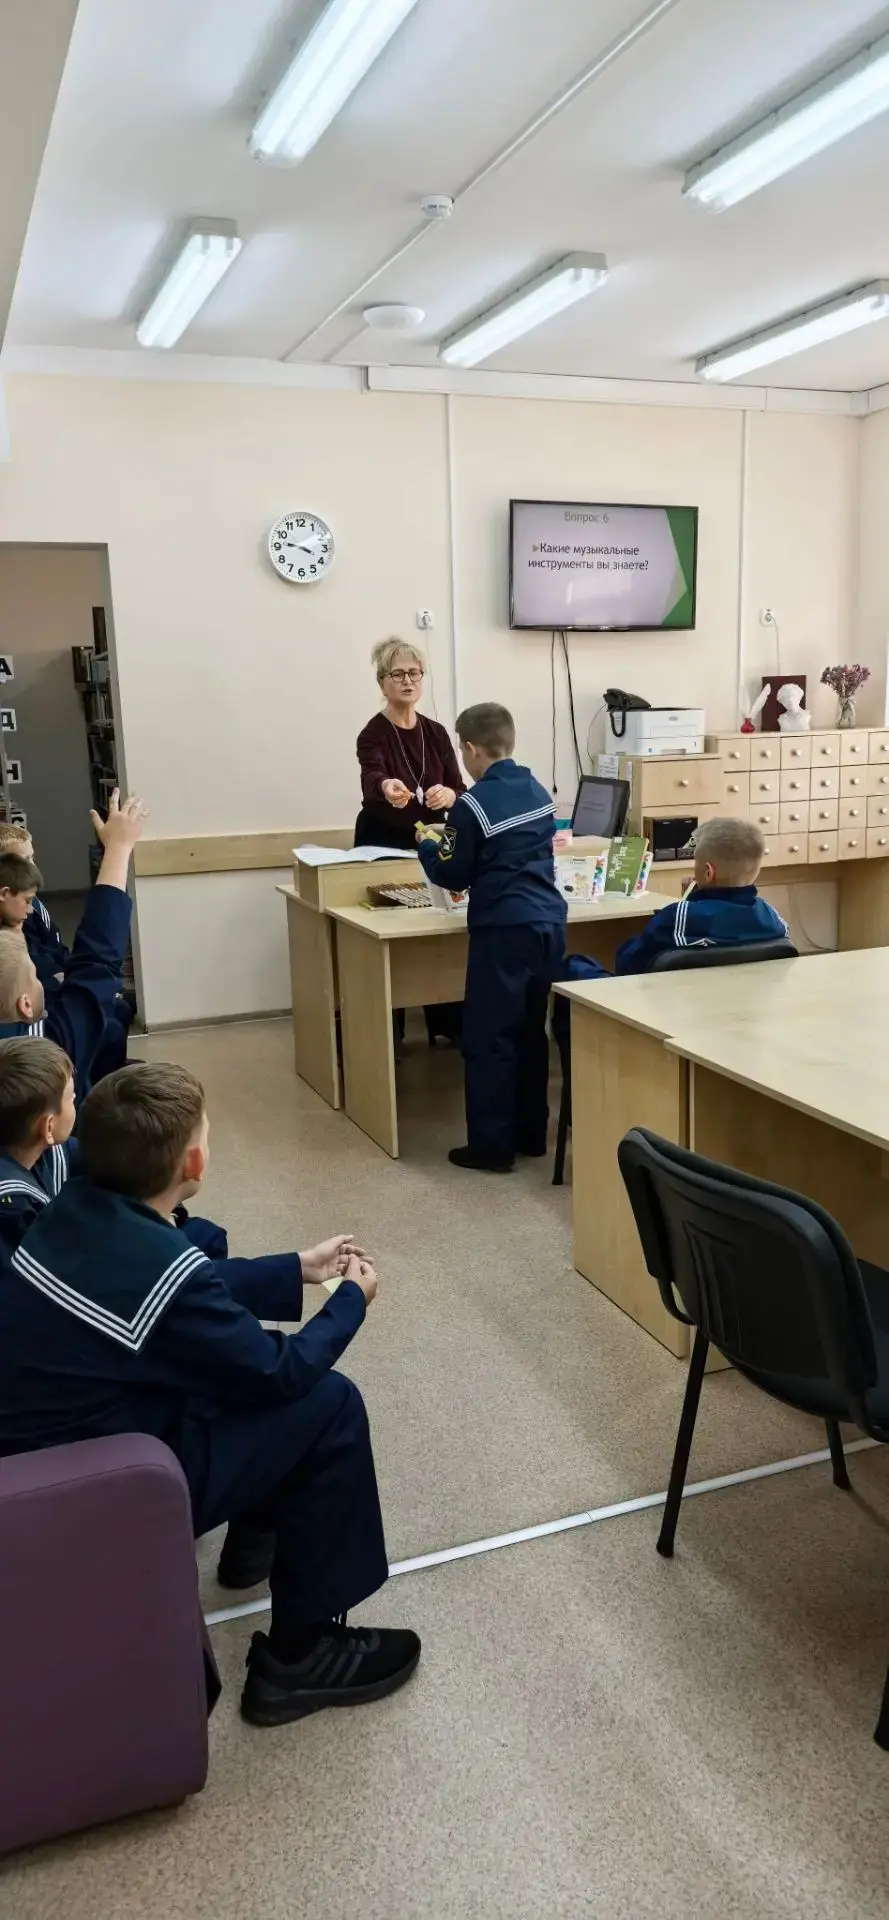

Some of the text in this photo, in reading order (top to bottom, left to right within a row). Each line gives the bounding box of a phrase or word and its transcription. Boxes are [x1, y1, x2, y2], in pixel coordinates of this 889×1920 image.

[564, 511, 610, 524] Вопрос 6
[285, 521, 294, 531] 11
[296, 518, 306, 528] 12
[310, 523, 315, 532] 1
[277, 530, 288, 540] 10
[273, 541, 282, 551] 9
[321, 544, 329, 553] 3
[540, 541, 640, 557] Какие музыкальные
[278, 554, 286, 564] 8
[317, 556, 325, 565] 4
[287, 563, 294, 573] 7
[309, 564, 317, 574] 5
[528, 559, 649, 571] инструменты вы знаете?
[297, 567, 306, 577] 6
